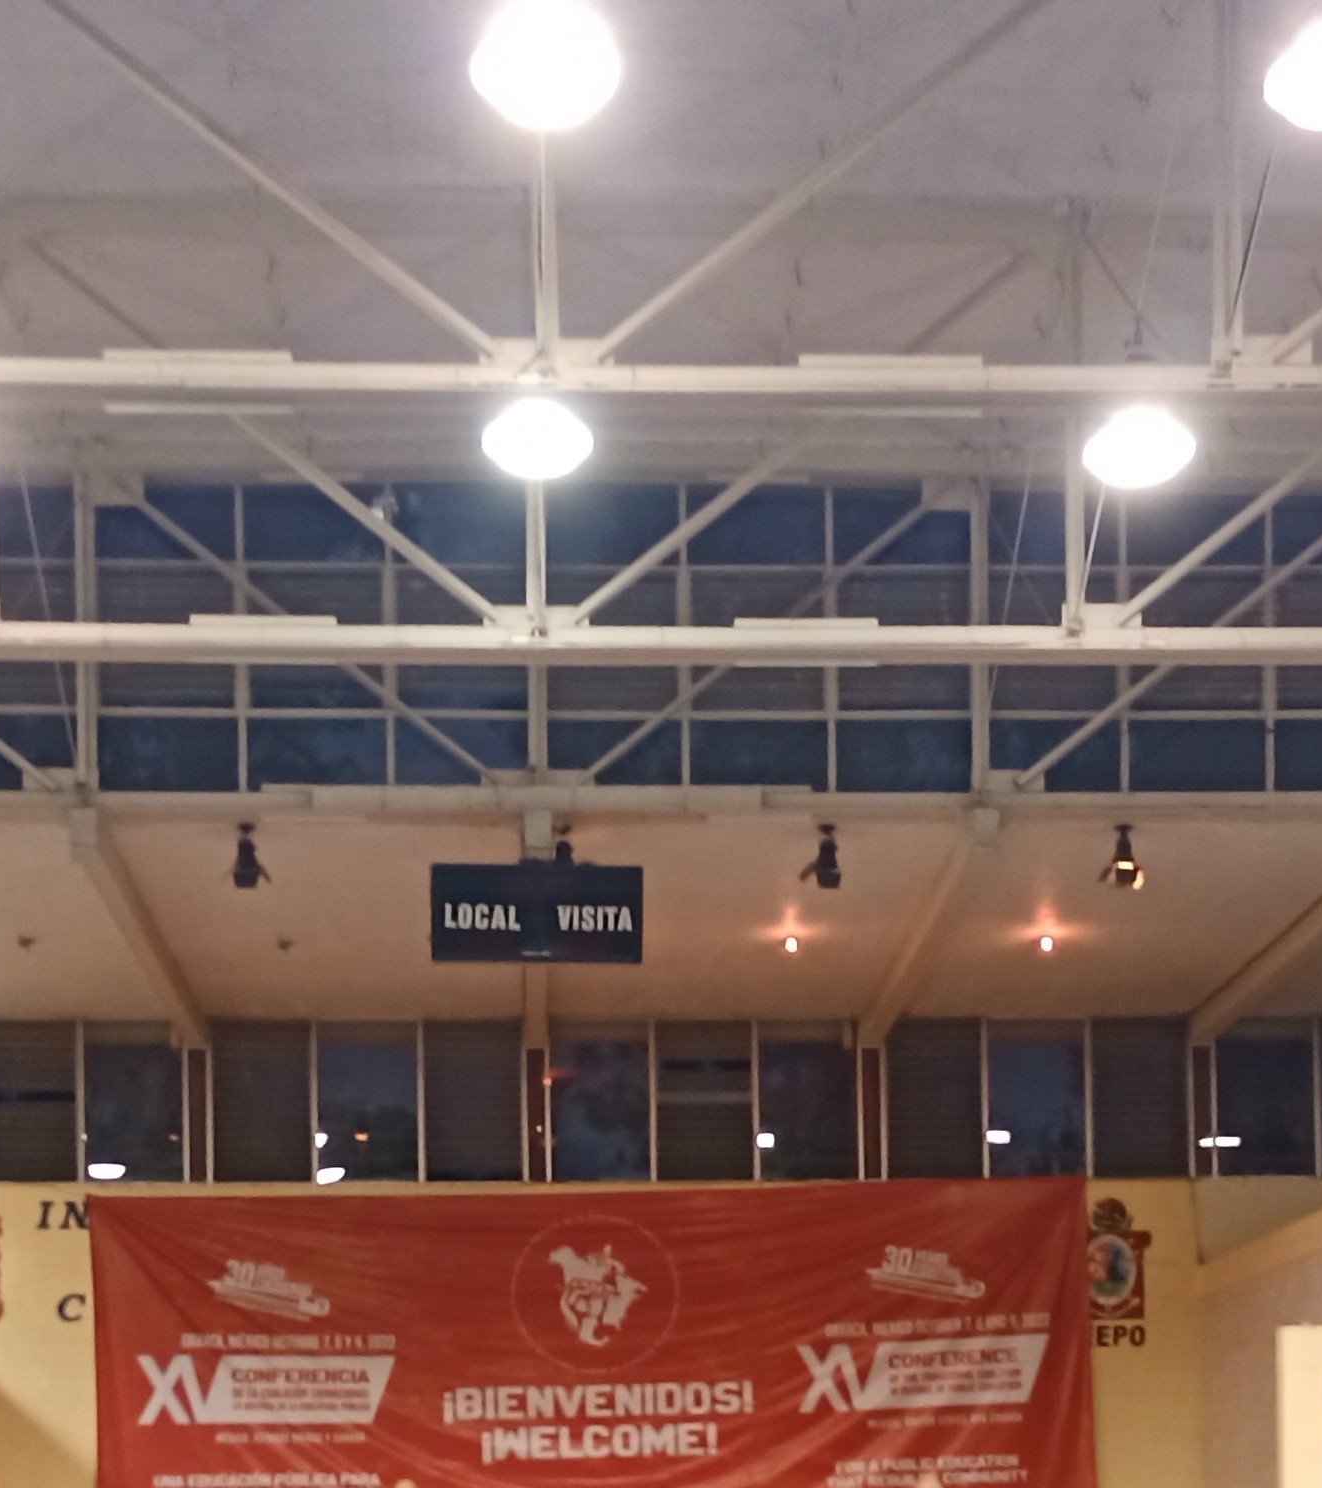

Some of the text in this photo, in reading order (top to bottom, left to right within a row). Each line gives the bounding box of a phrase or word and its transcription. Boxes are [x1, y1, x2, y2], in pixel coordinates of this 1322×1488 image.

[443, 902, 633, 932] LOCAL VISITA
[231, 1367, 371, 1384] CONFERENCIA
[796, 1342, 882, 1415] XV
[888, 1348, 1019, 1369] CONFERENCE
[136, 1353, 227, 1426] XV
[443, 1379, 754, 1425] ¡BIENVENIDOS!
[481, 1421, 719, 1465] ¡WELCOME!
